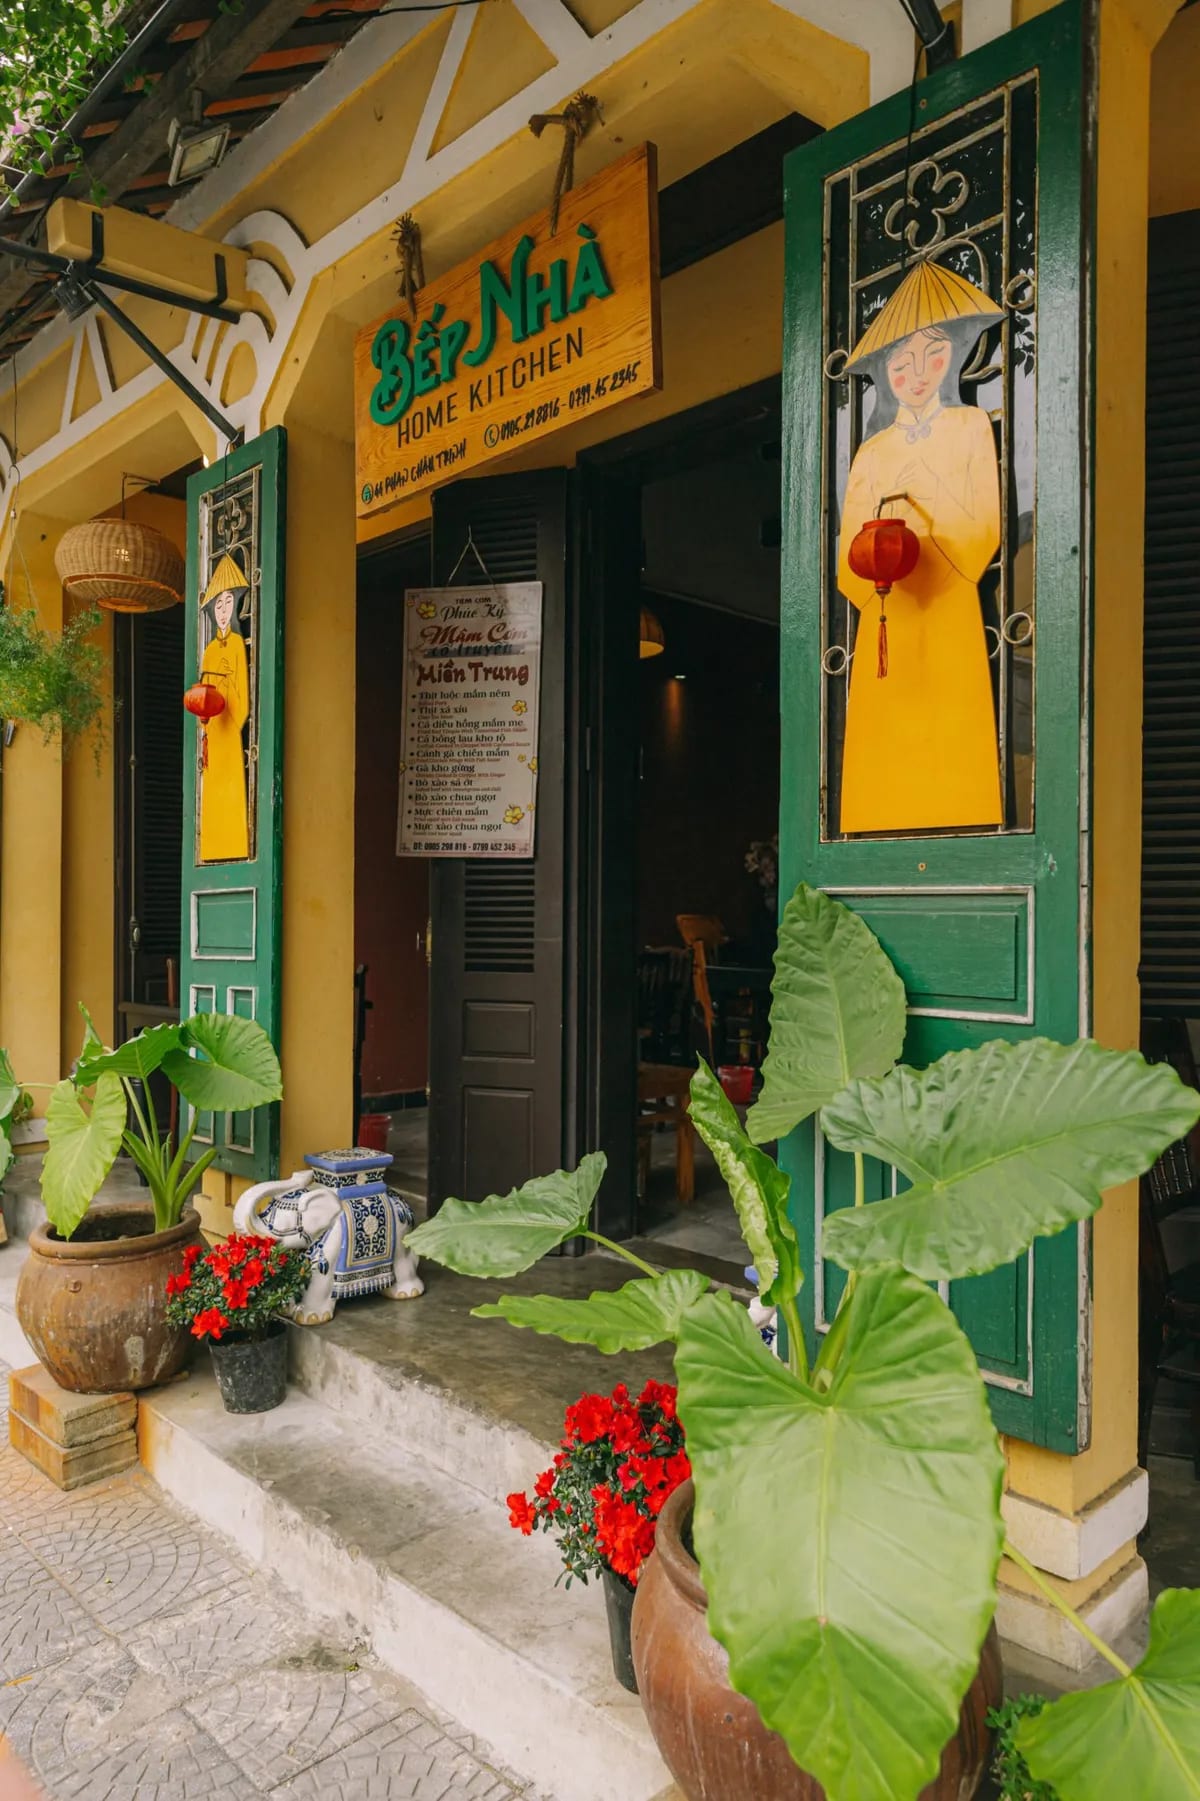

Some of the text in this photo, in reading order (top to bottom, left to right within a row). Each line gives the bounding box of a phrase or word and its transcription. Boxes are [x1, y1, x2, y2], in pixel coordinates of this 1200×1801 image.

[369, 222, 614, 426] BẾP NHÀ
[397, 327, 583, 448] HOME KITCHEN
[420, 624, 484, 645] Mâm
[416, 659, 529, 687] Miền Trung
